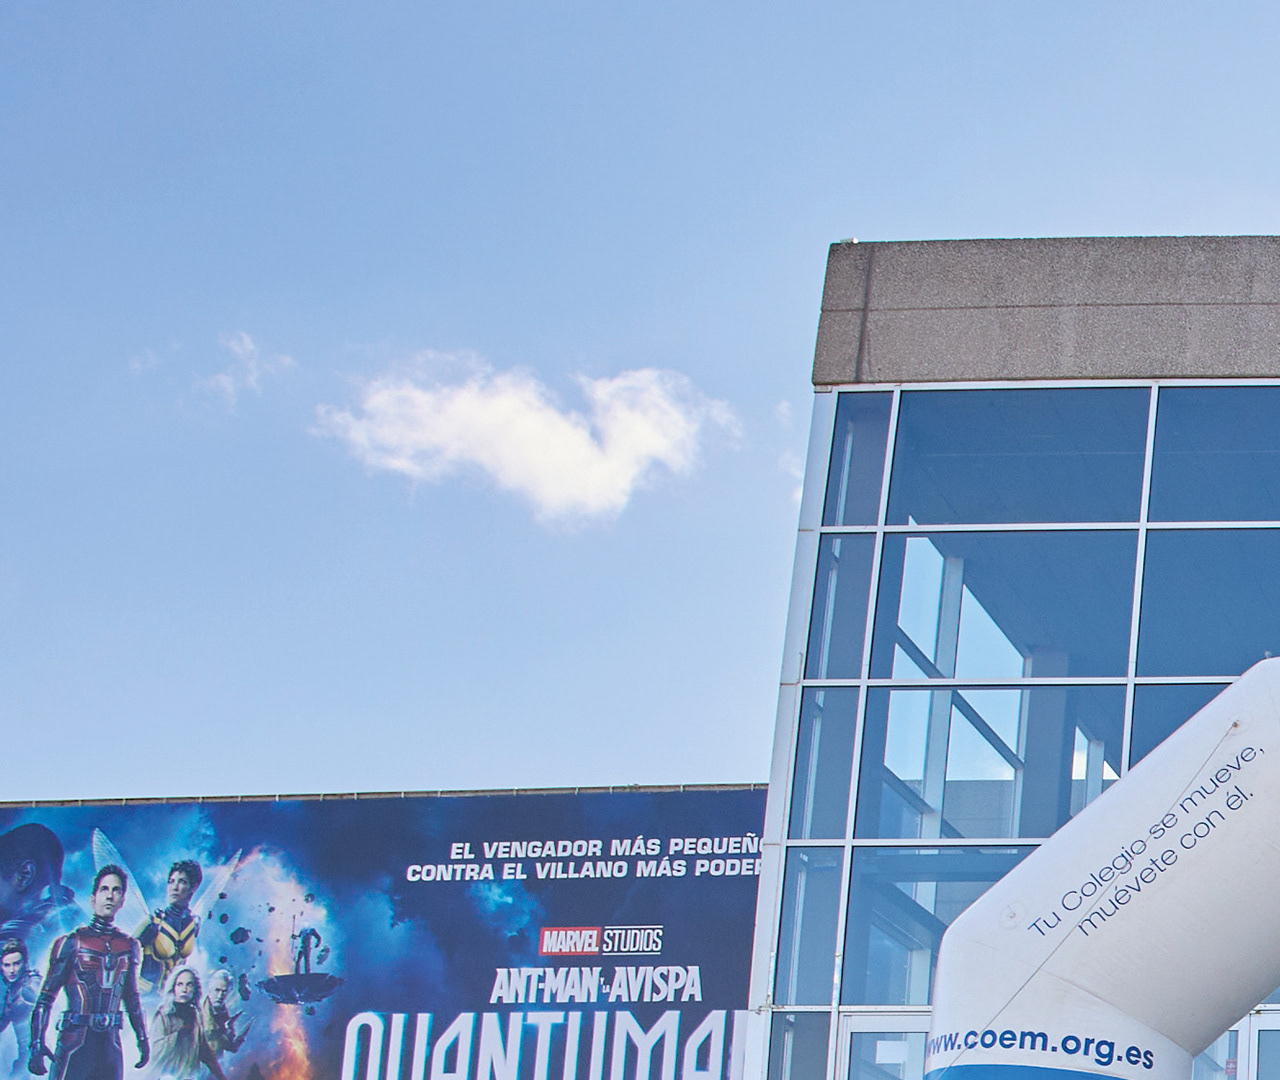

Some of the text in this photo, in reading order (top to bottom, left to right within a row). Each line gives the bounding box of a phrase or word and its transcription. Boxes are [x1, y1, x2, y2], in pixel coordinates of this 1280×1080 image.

[450, 832, 763, 860] EL VENGADOR MÁS PEQUEÑ
[1027, 745, 1265, 936] Tu Colegio se mueve,
[406, 863, 494, 882] CONTRA
[502, 862, 527, 880] EL
[535, 860, 628, 880] VILLANO
[636, 856, 687, 878] MÁS
[1078, 785, 1254, 937] muévete con él.
[542, 930, 599, 953] MARVEL
[602, 929, 663, 952] STUDIOS
[489, 967, 603, 1004] ANT-MAN
[608, 966, 703, 1002] AVISPA
